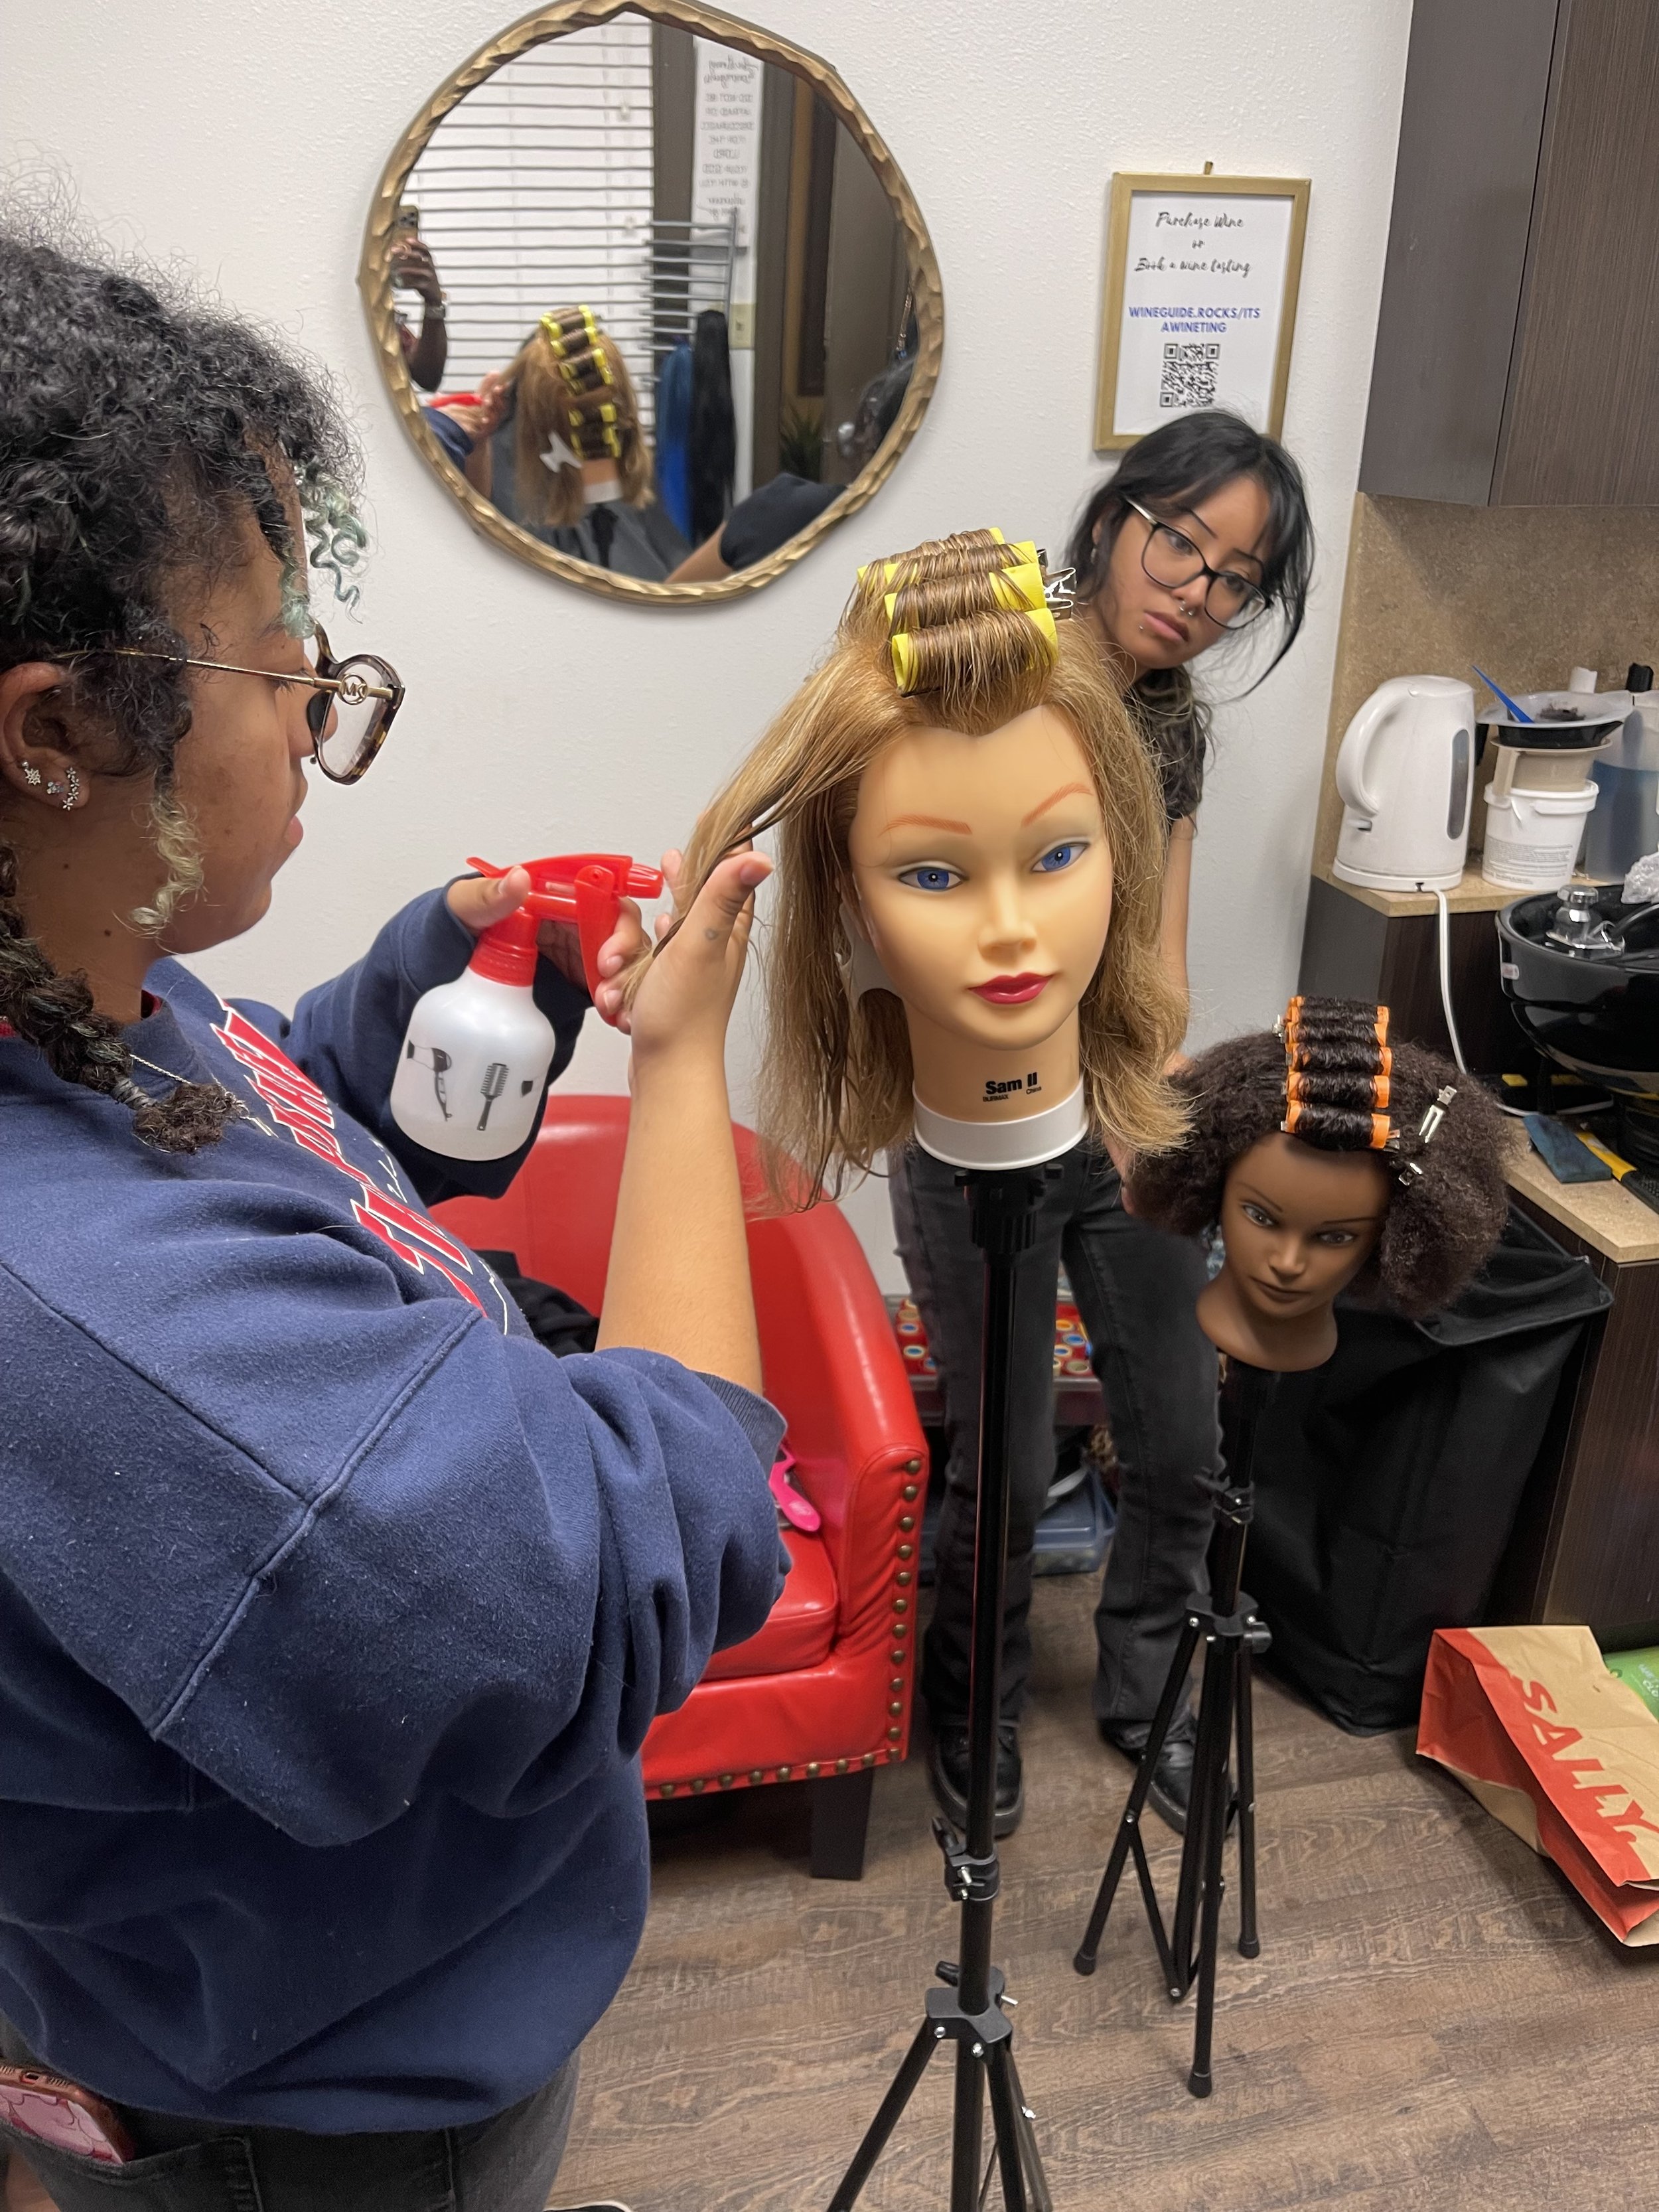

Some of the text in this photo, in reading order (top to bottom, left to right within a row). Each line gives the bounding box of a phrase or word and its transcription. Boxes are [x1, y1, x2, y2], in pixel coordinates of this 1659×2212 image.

[1155, 212, 1244, 230] Purchase Wine
[1134, 256, 1165, 271] Book
[1180, 260, 1207, 271] wine
[1210, 258, 1251, 278] tasting
[1128, 306, 1260, 319] WINEGUIDE.ROCKS/ITS
[985, 1079, 1022, 1094] Sam
[1512, 1674, 1659, 1844] SALLY
